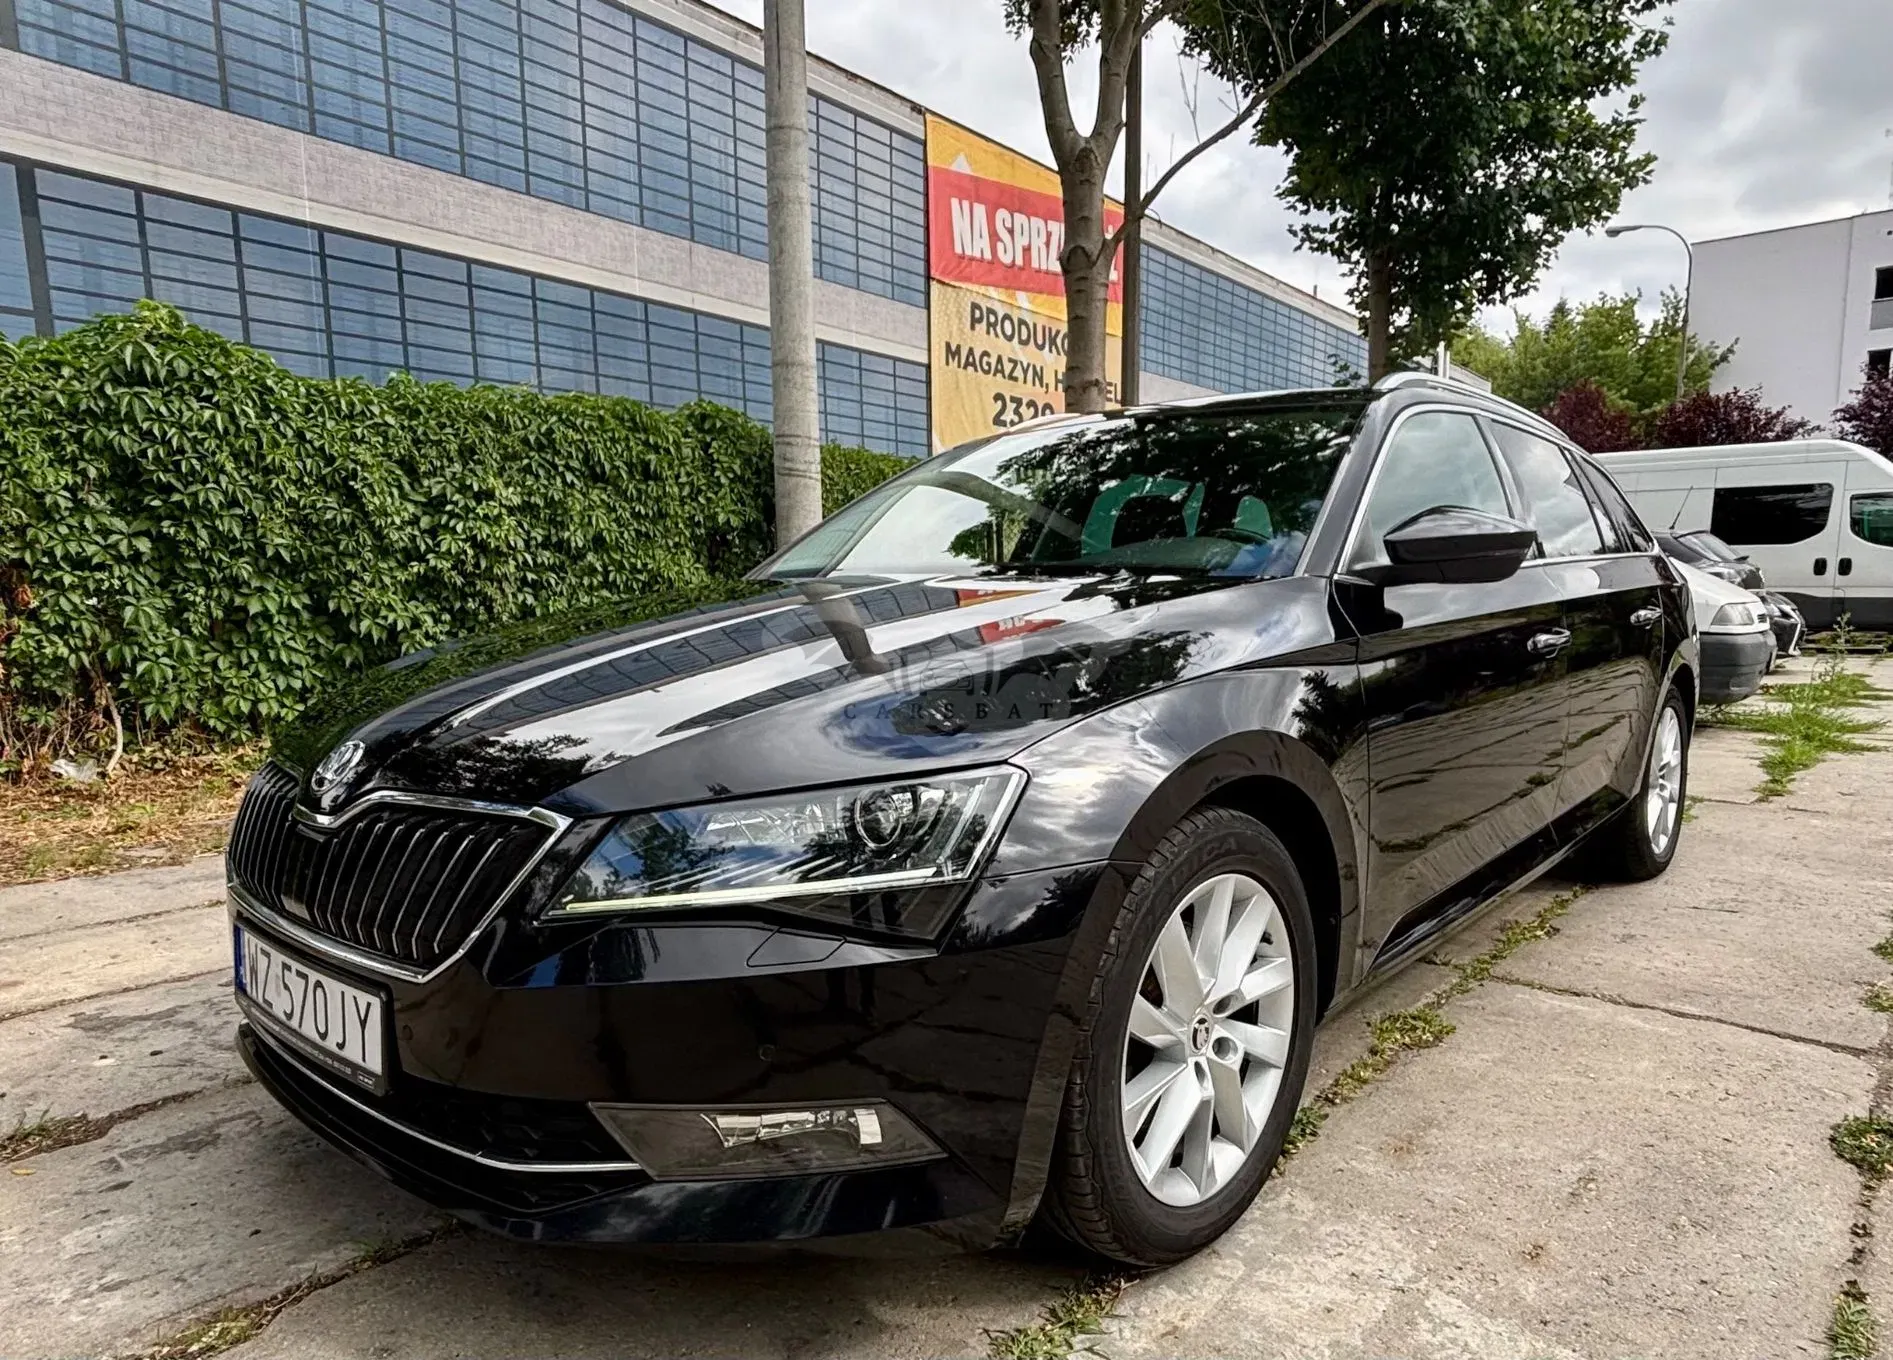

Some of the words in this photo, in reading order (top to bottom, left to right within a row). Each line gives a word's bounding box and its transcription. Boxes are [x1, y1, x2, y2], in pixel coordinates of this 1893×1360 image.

[951, 197, 992, 261] NA
[945, 341, 1050, 394] MAGAZYN,
[281, 960, 372, 1063] 570JY
